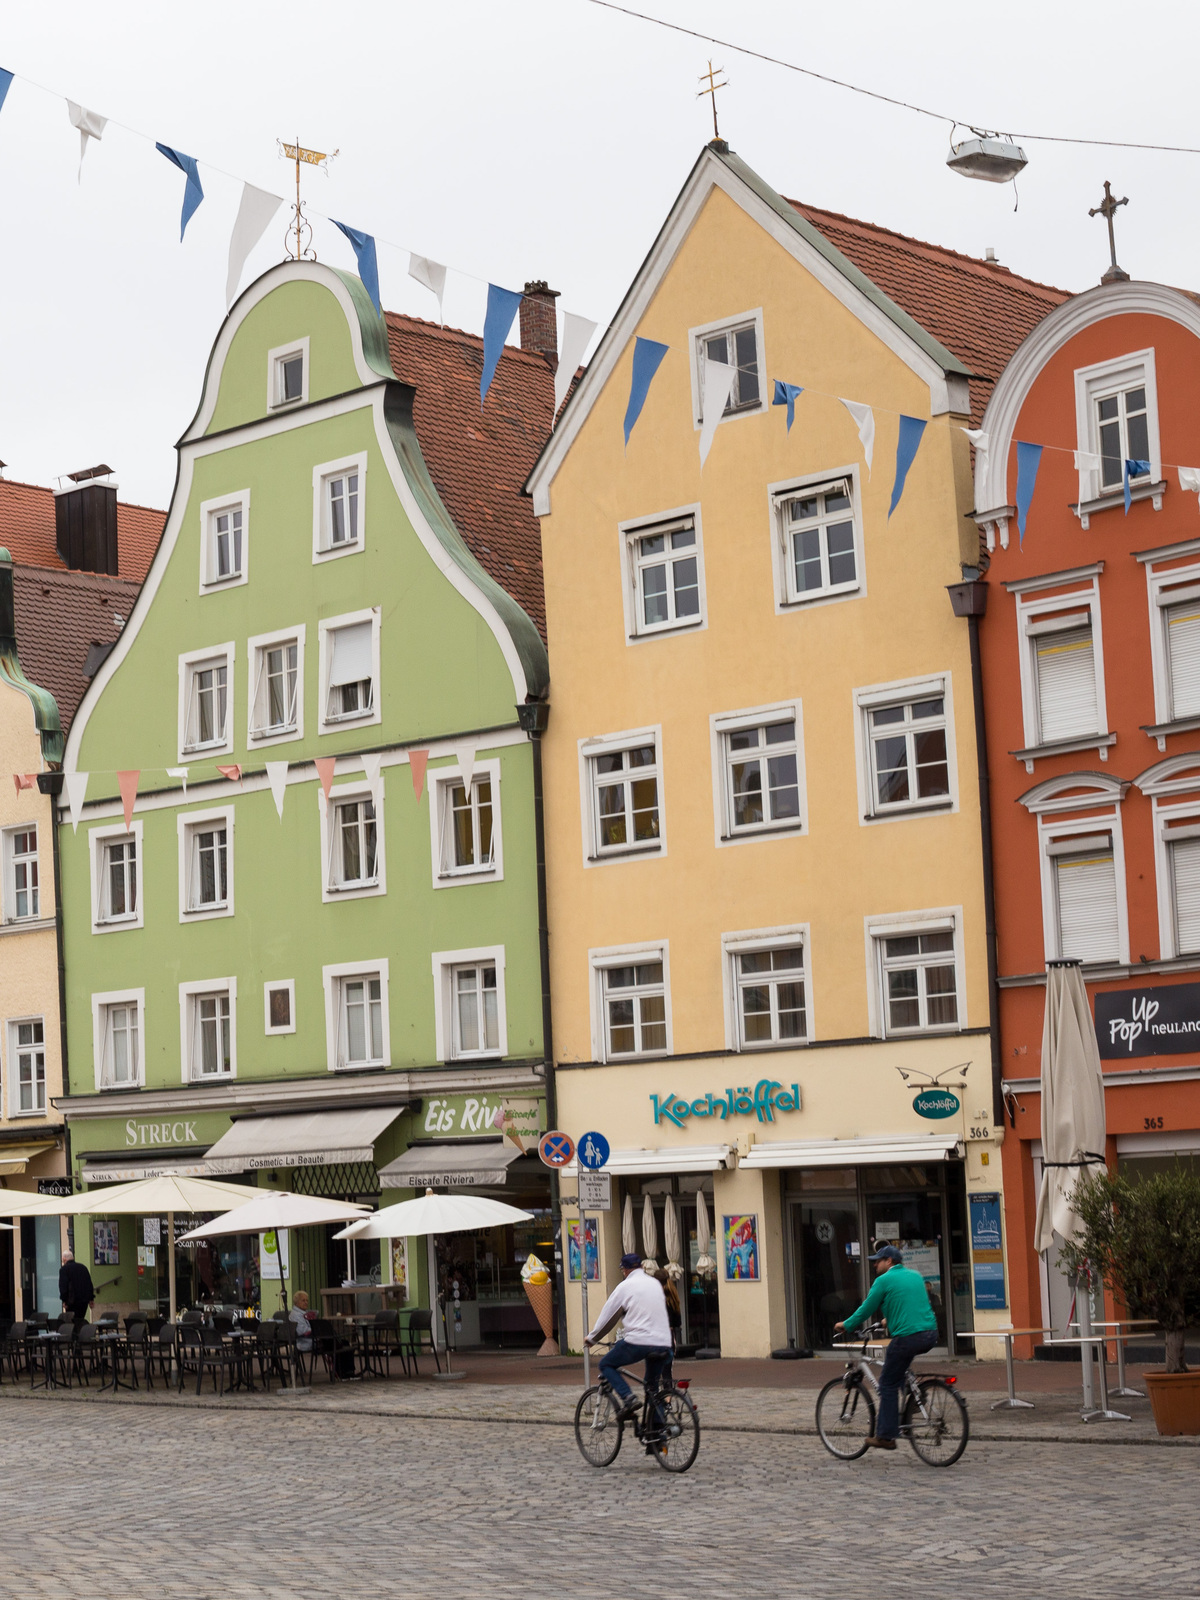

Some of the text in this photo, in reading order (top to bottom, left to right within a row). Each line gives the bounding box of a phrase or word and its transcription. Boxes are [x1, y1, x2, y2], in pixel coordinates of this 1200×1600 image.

[1132, 996, 1160, 1032] Up
[1108, 1018, 1143, 1052] Pop
[649, 1079, 801, 1128] Kochlöffel
[917, 1098, 957, 1111] Kochlöffel
[424, 1099, 456, 1132] Eis
[1143, 1117, 1164, 1130] 365
[125, 1119, 198, 1146] STRECK
[505, 1126, 539, 1137] Riviera
[969, 1127, 989, 1139] 366
[249, 1154, 324, 1168] Cosmetic La Beauté
[408, 1174, 475, 1186] Eiscafe Riviera
